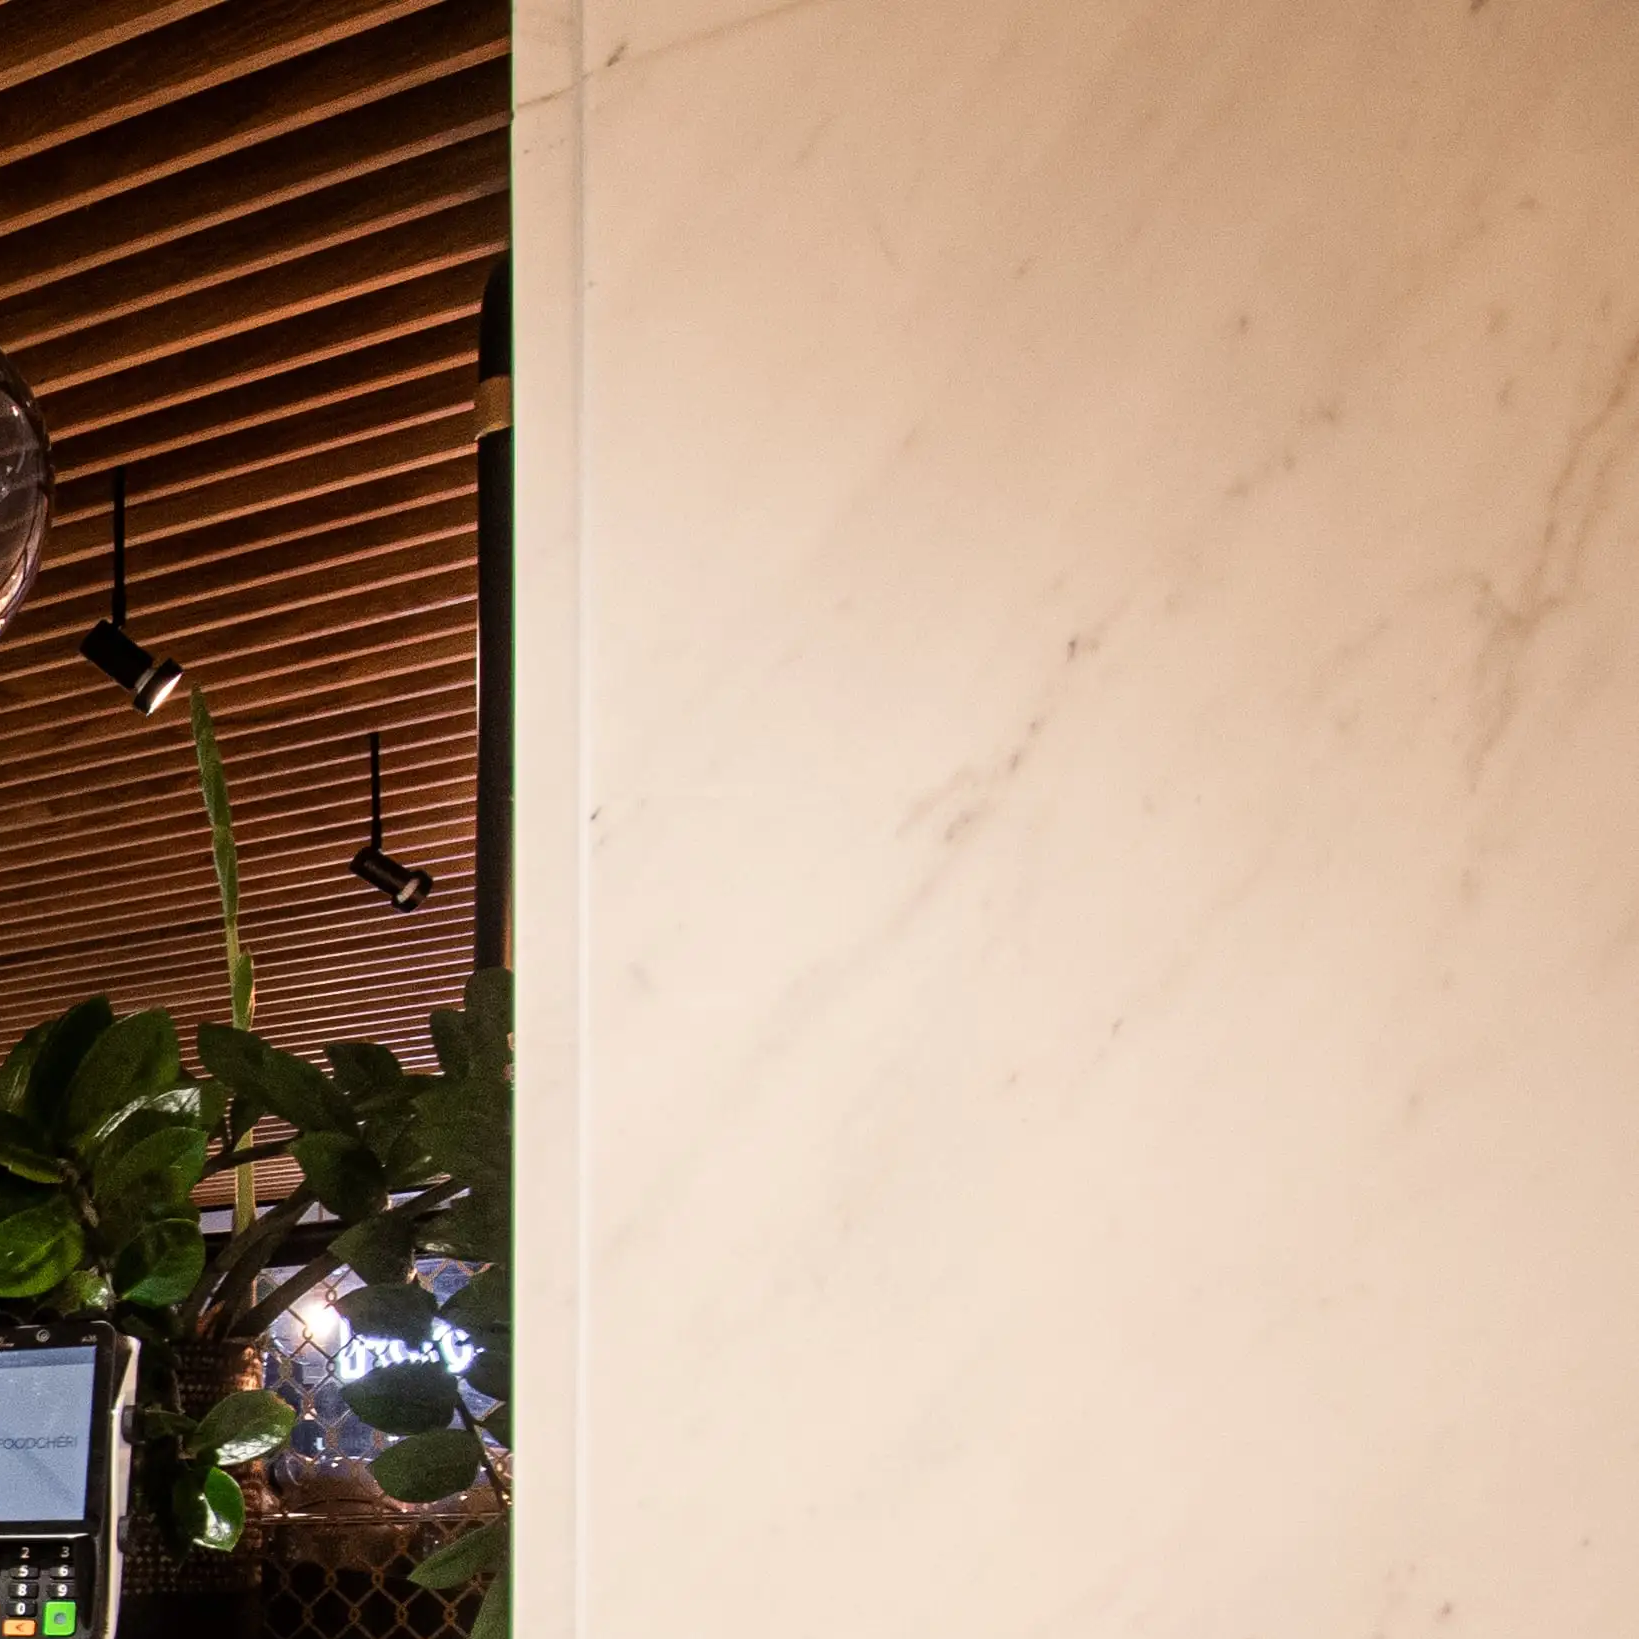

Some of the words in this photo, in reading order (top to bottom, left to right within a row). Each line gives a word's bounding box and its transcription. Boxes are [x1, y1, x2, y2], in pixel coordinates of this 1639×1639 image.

[20, 1546, 30, 1559] 2
[60, 1545, 70, 1558] 3
[19, 1565, 29, 1577] 5
[59, 1565, 69, 1577] 6
[17, 1584, 28, 1597] 8
[57, 1584, 68, 1597] 9
[15, 1602, 26, 1615] 0
